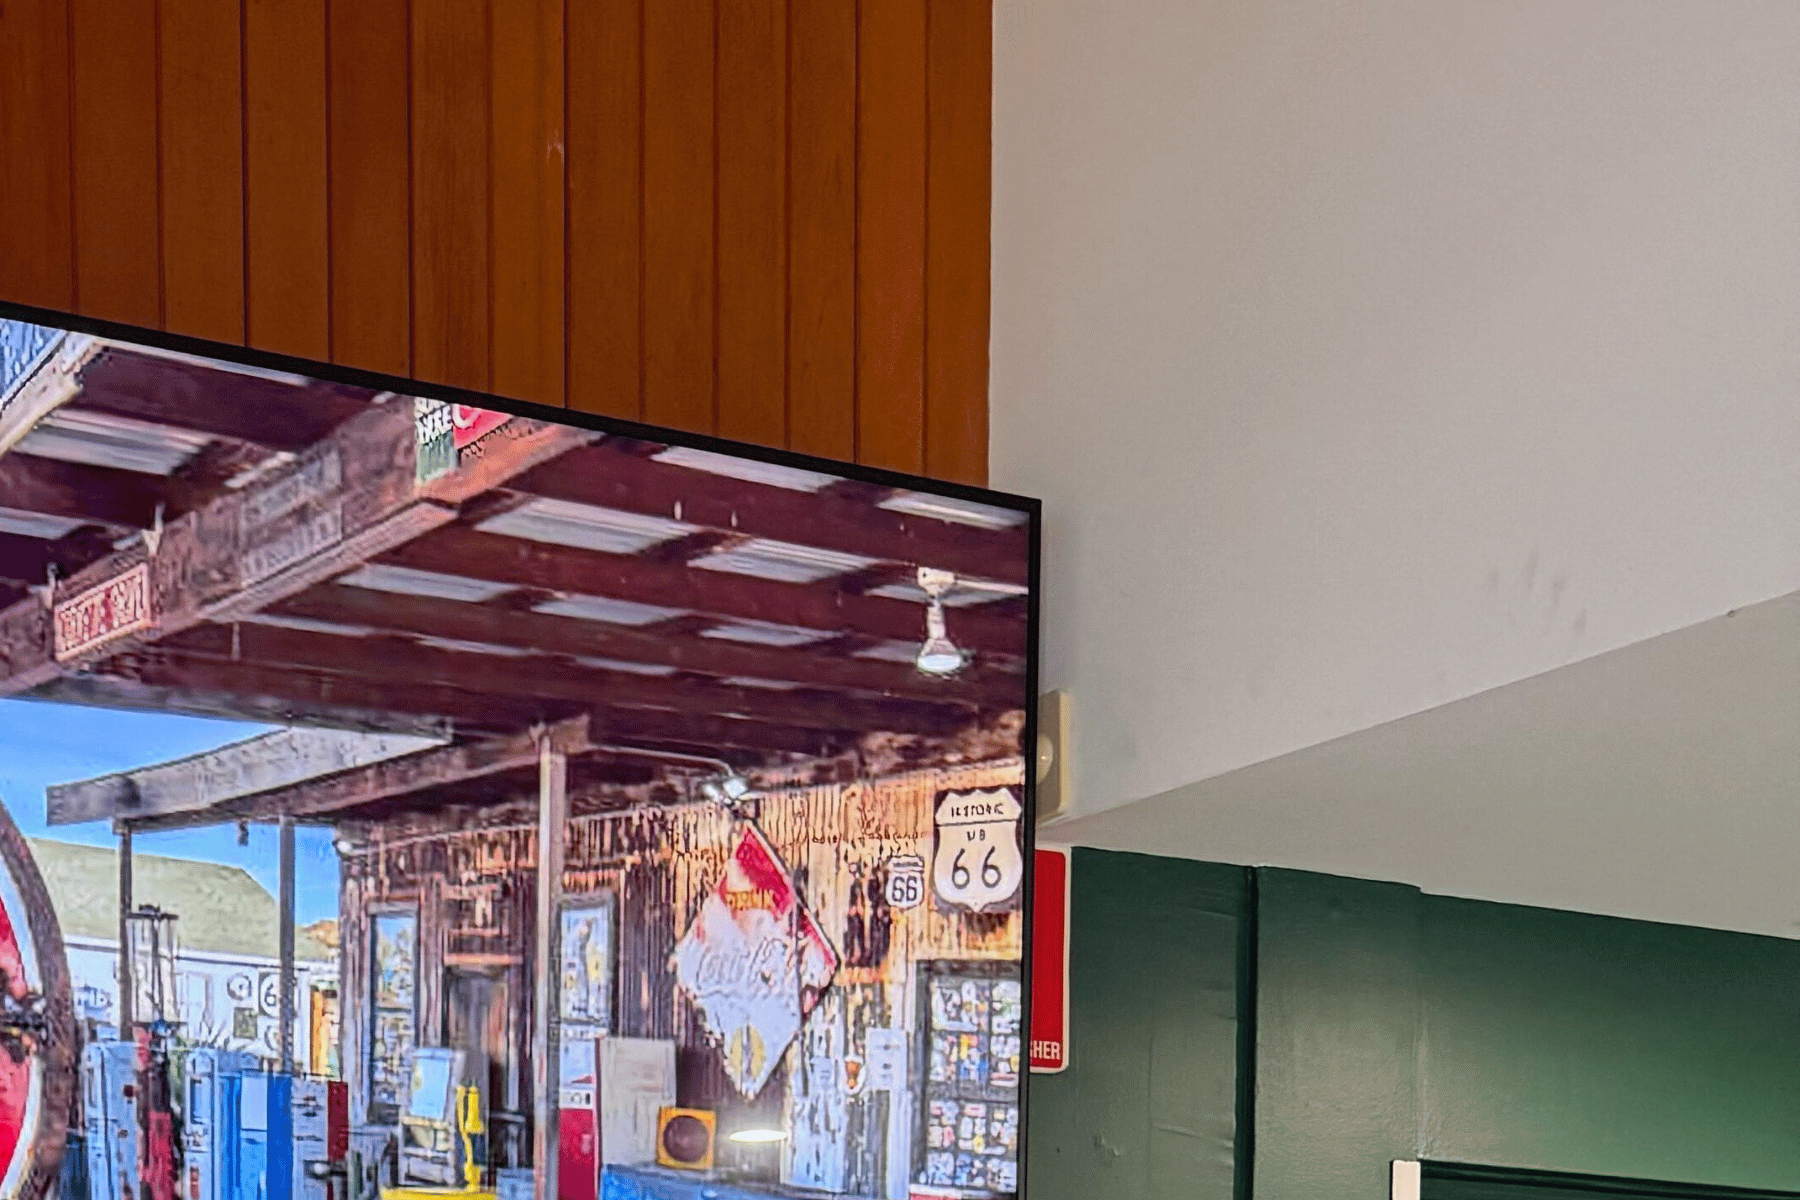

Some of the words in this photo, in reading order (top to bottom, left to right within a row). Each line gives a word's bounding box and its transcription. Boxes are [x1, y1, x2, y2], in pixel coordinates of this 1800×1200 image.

[951, 846, 1002, 890] 66
[892, 875, 918, 902] 66
[1030, 1040, 1060, 1060] HER
